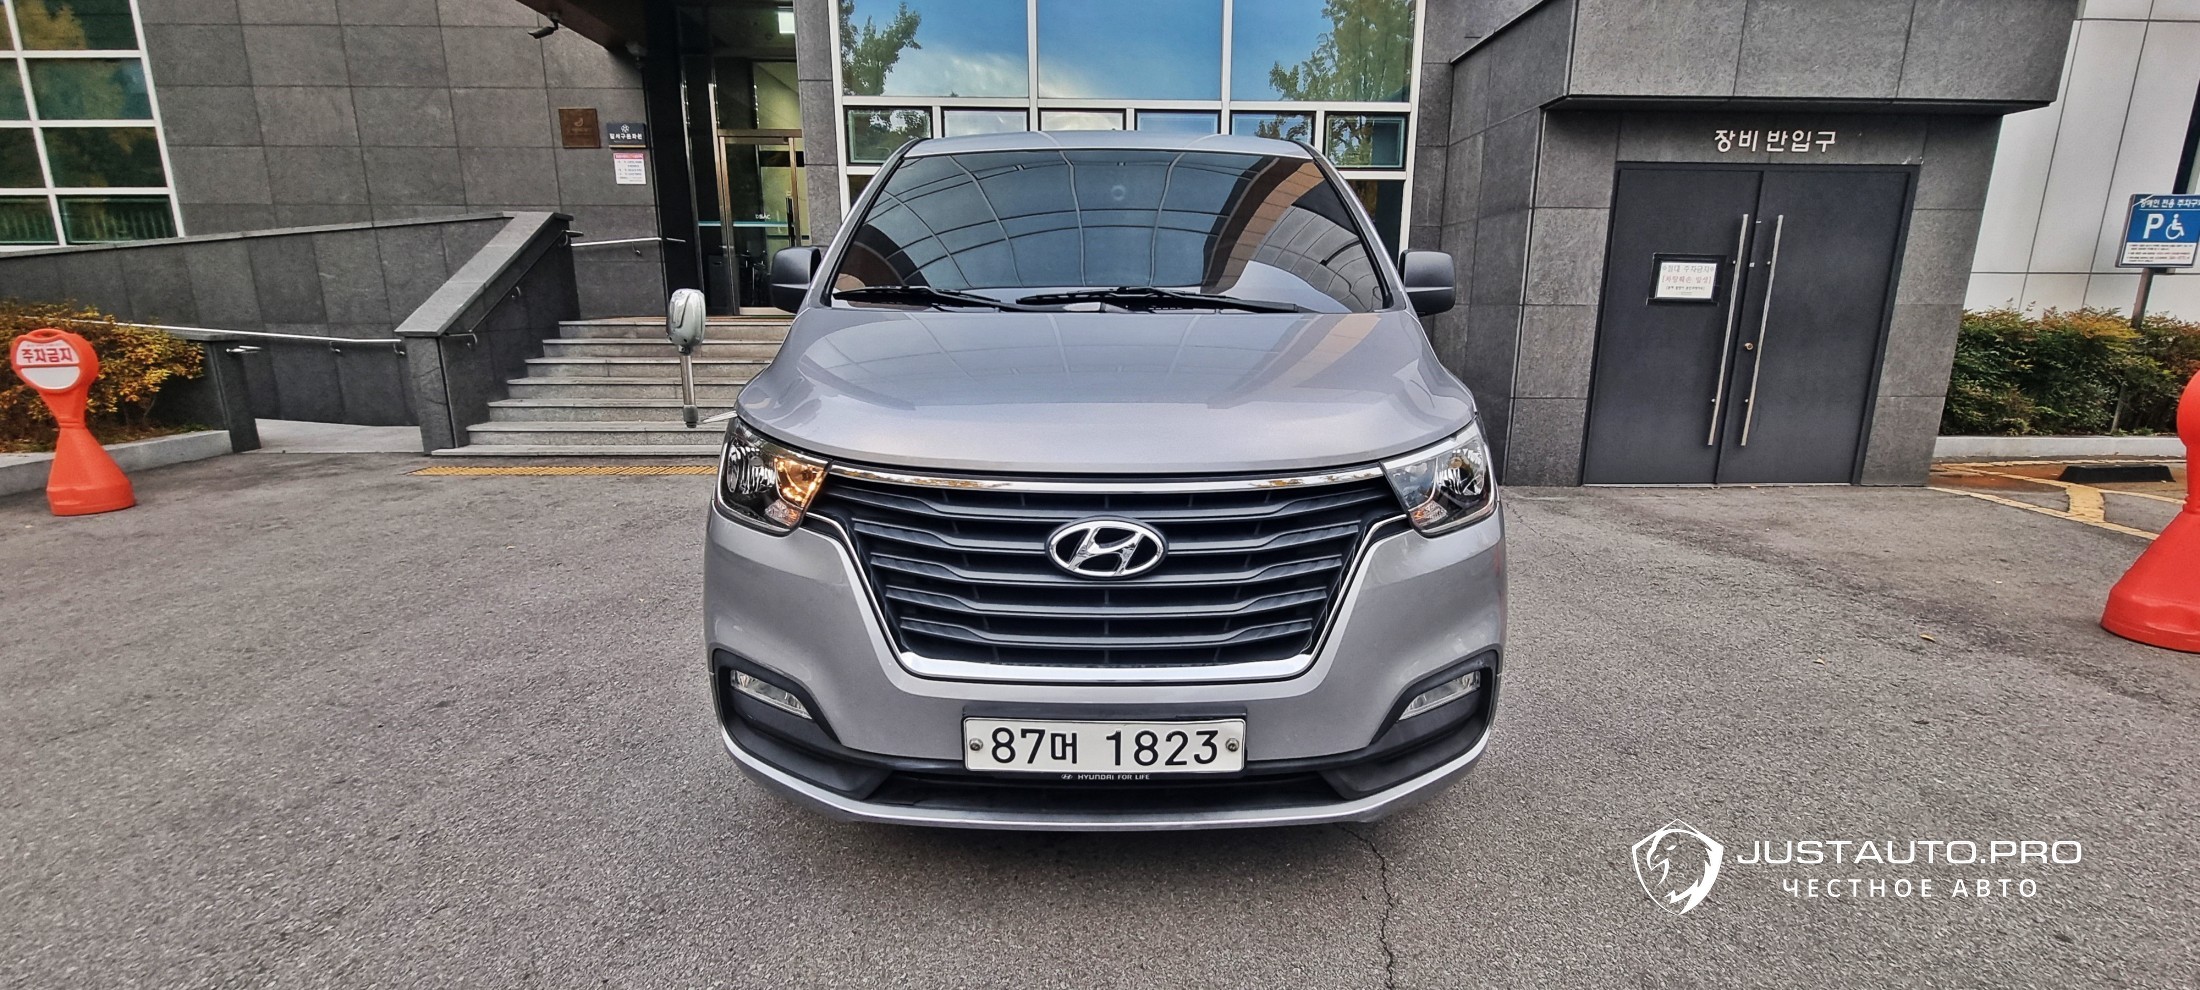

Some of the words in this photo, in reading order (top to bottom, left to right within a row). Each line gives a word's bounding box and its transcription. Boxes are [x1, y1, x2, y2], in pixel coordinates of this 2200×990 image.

[1714, 129, 1759, 153] 장비
[1766, 129, 1837, 153] 반입구
[2143, 213, 2164, 239] P
[21, 347, 73, 363] 주차금지
[991, 727, 1077, 765] 87머
[1105, 729, 1219, 767] 1823
